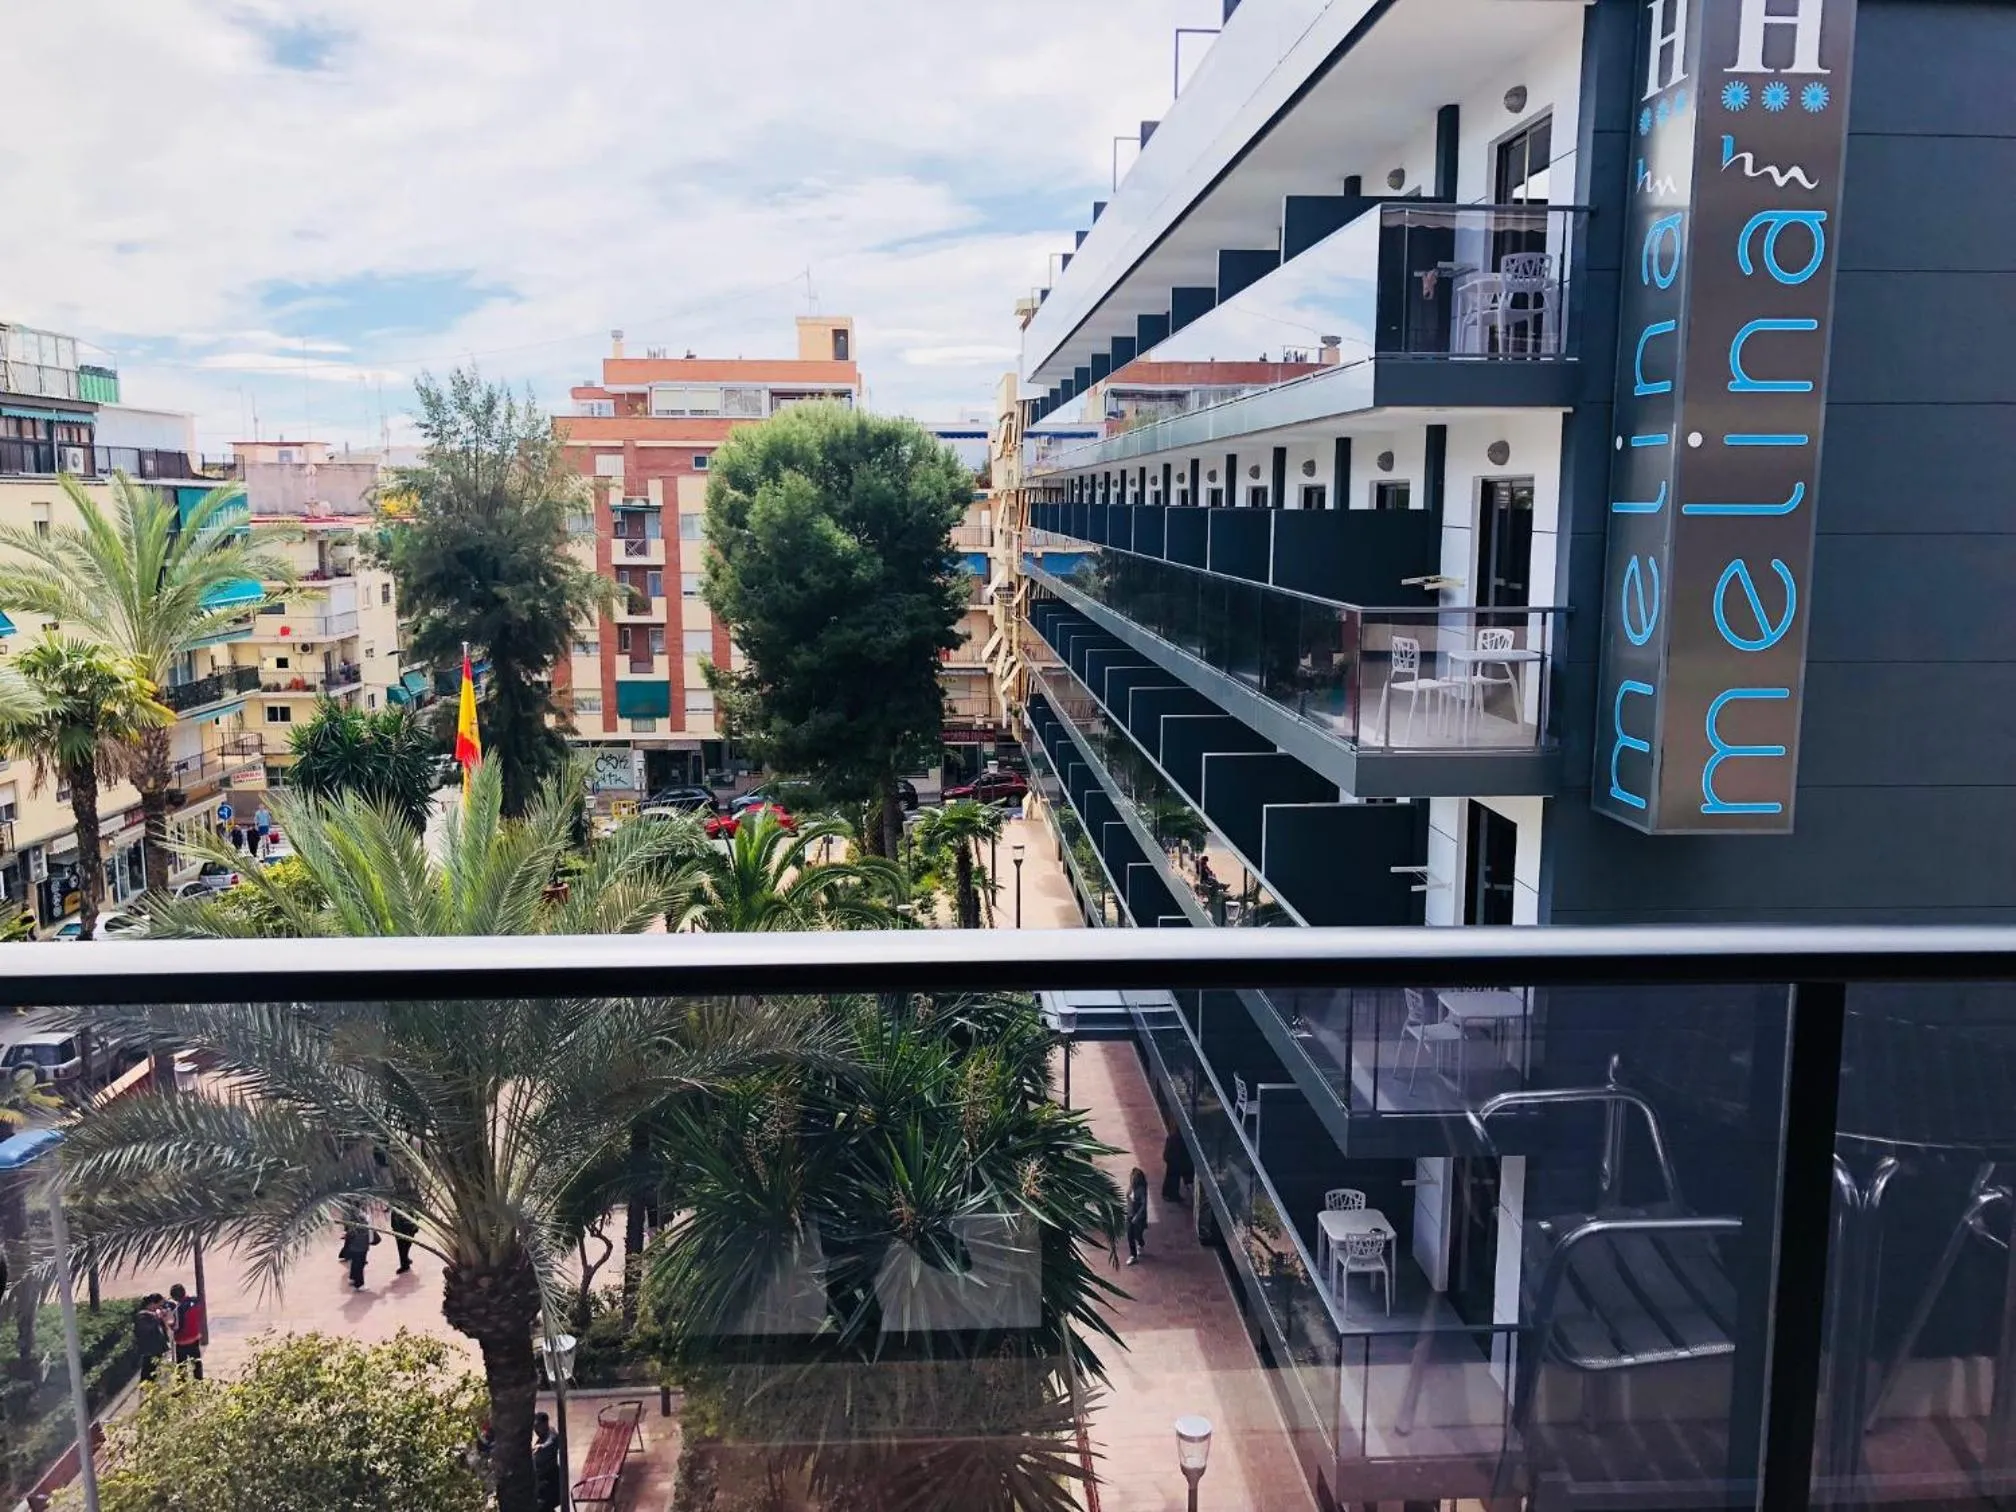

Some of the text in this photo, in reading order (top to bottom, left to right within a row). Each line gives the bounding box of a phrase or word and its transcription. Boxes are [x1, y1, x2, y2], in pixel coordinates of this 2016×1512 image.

[1723, 0, 1831, 73] H
[1610, 212, 1683, 810] melina
[1682, 210, 1827, 814] melina
